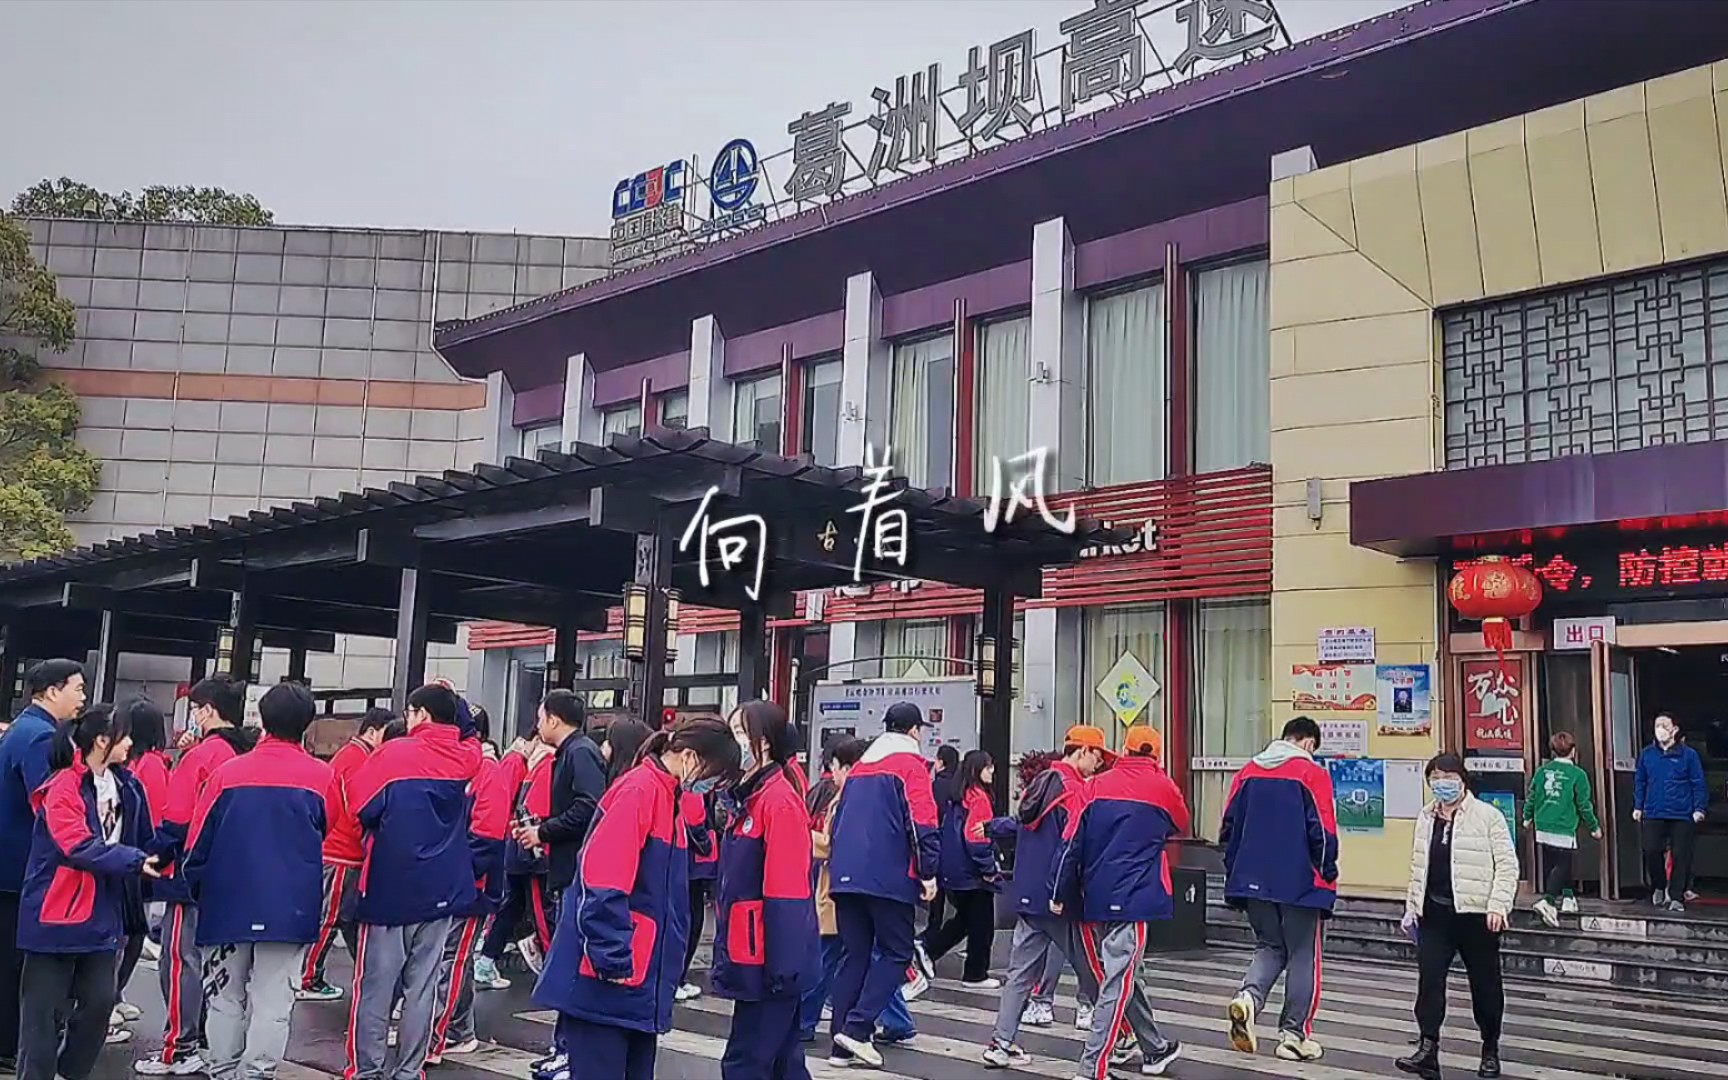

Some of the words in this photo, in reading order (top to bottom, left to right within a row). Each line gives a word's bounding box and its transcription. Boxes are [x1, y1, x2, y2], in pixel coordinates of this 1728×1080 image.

[784, 0, 1278, 202] 葛洲坝高速
[1566, 623, 1604, 643] 出口
